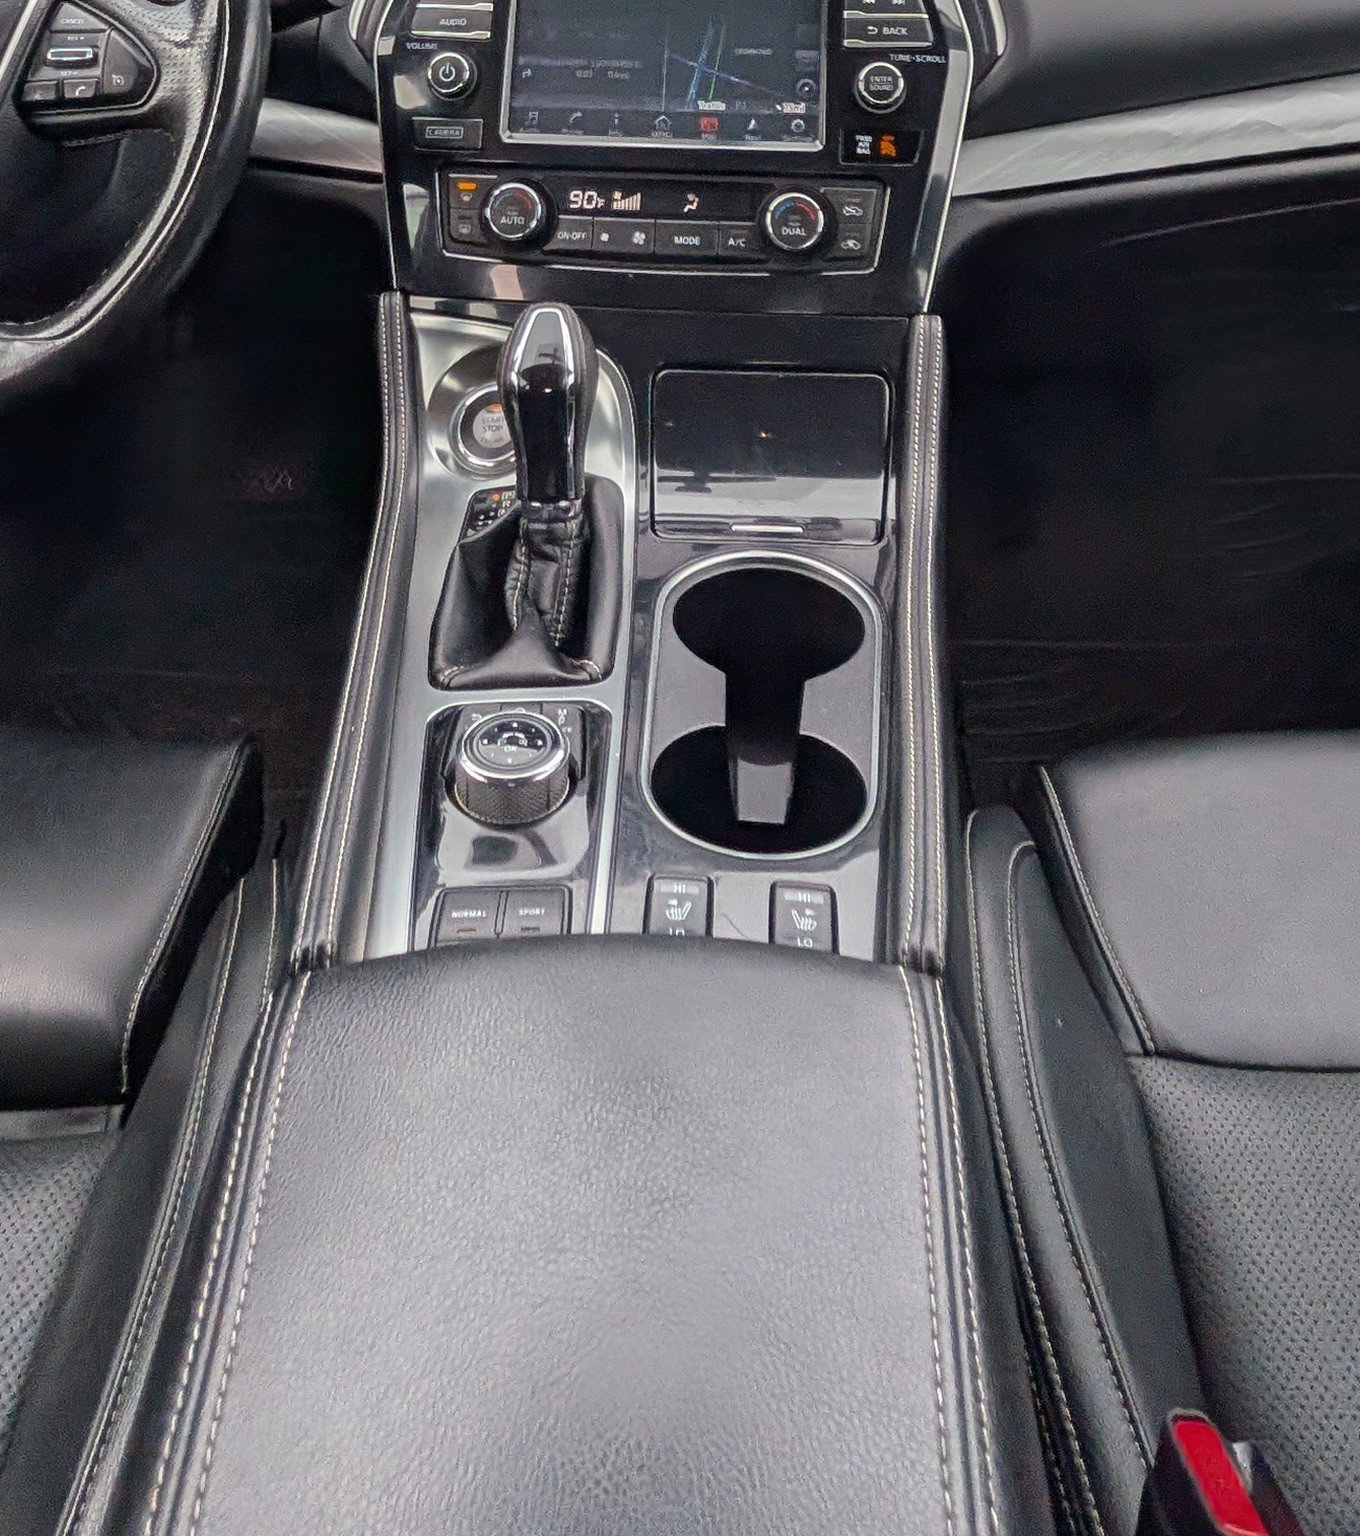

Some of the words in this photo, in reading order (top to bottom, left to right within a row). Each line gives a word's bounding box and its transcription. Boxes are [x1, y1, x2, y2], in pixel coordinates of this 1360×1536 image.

[439, 18, 467, 26] AUDIO
[882, 26, 909, 36] BACK
[499, 216, 525, 225] AUTO
[781, 226, 807, 236] DUAL
[674, 236, 701, 246] MODE
[728, 237, 747, 247] A/C
[482, 425, 504, 433] STOP
[673, 883, 686, 893] HI
[797, 892, 811, 902] HI
[451, 909, 487, 919] NORMAL
[517, 907, 546, 917] SPORT
[796, 937, 814, 948] LO
